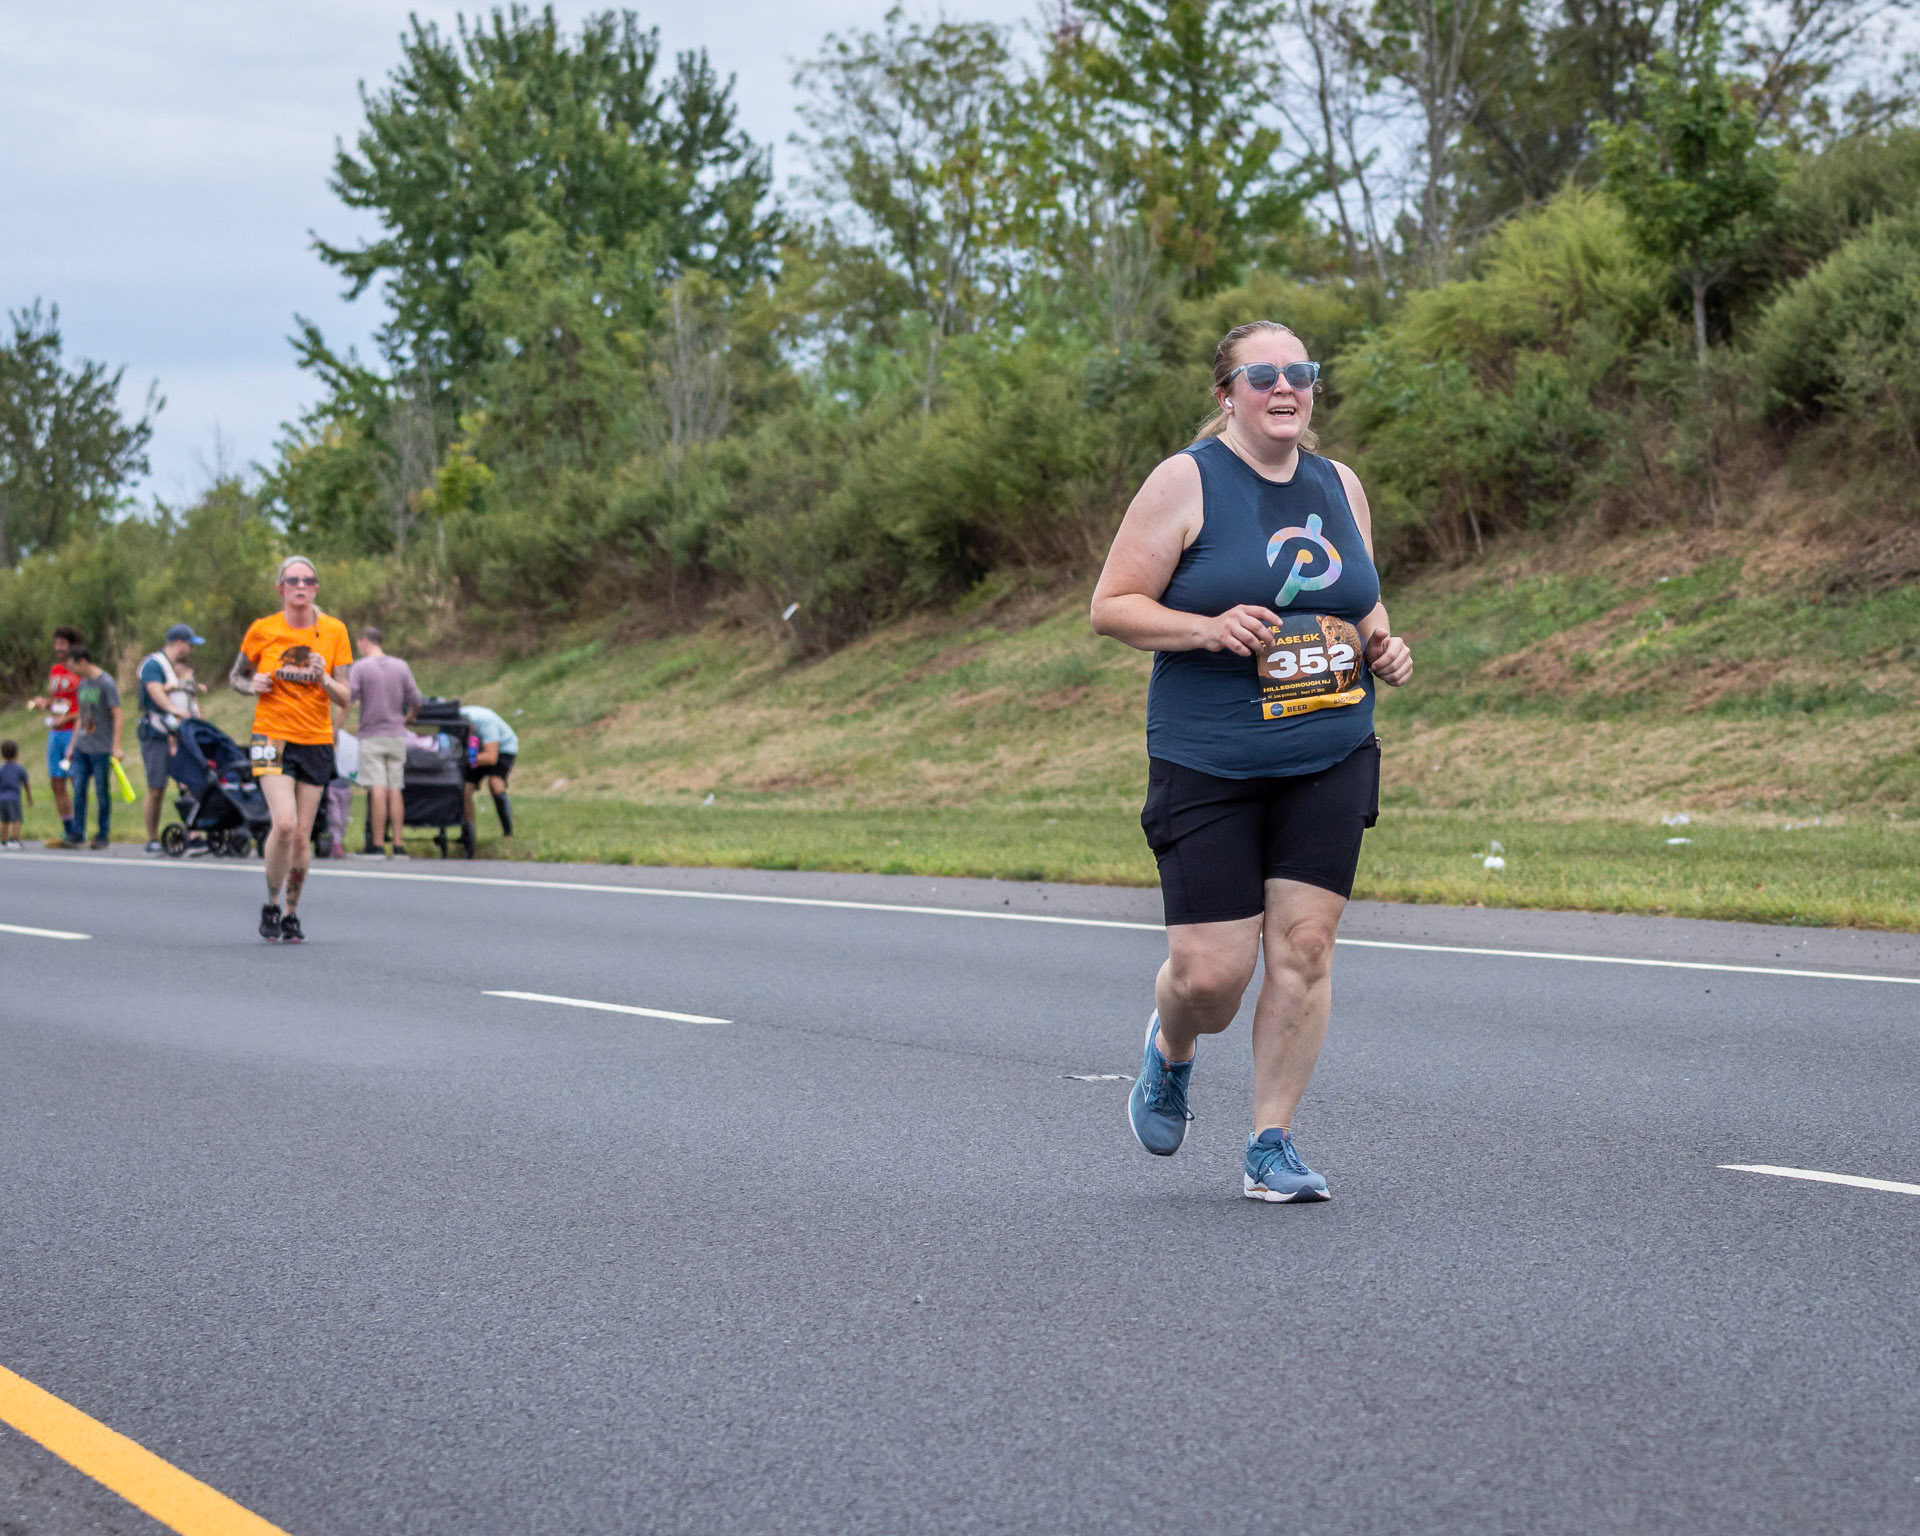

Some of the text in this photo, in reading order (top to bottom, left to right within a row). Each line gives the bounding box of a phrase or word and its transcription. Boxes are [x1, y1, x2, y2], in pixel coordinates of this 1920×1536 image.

[1303, 632, 1321, 643] 5K
[1266, 643, 1355, 679] 352
[1263, 680, 1321, 693] HILLSBOROUGH
[1287, 704, 1308, 712] BEER
